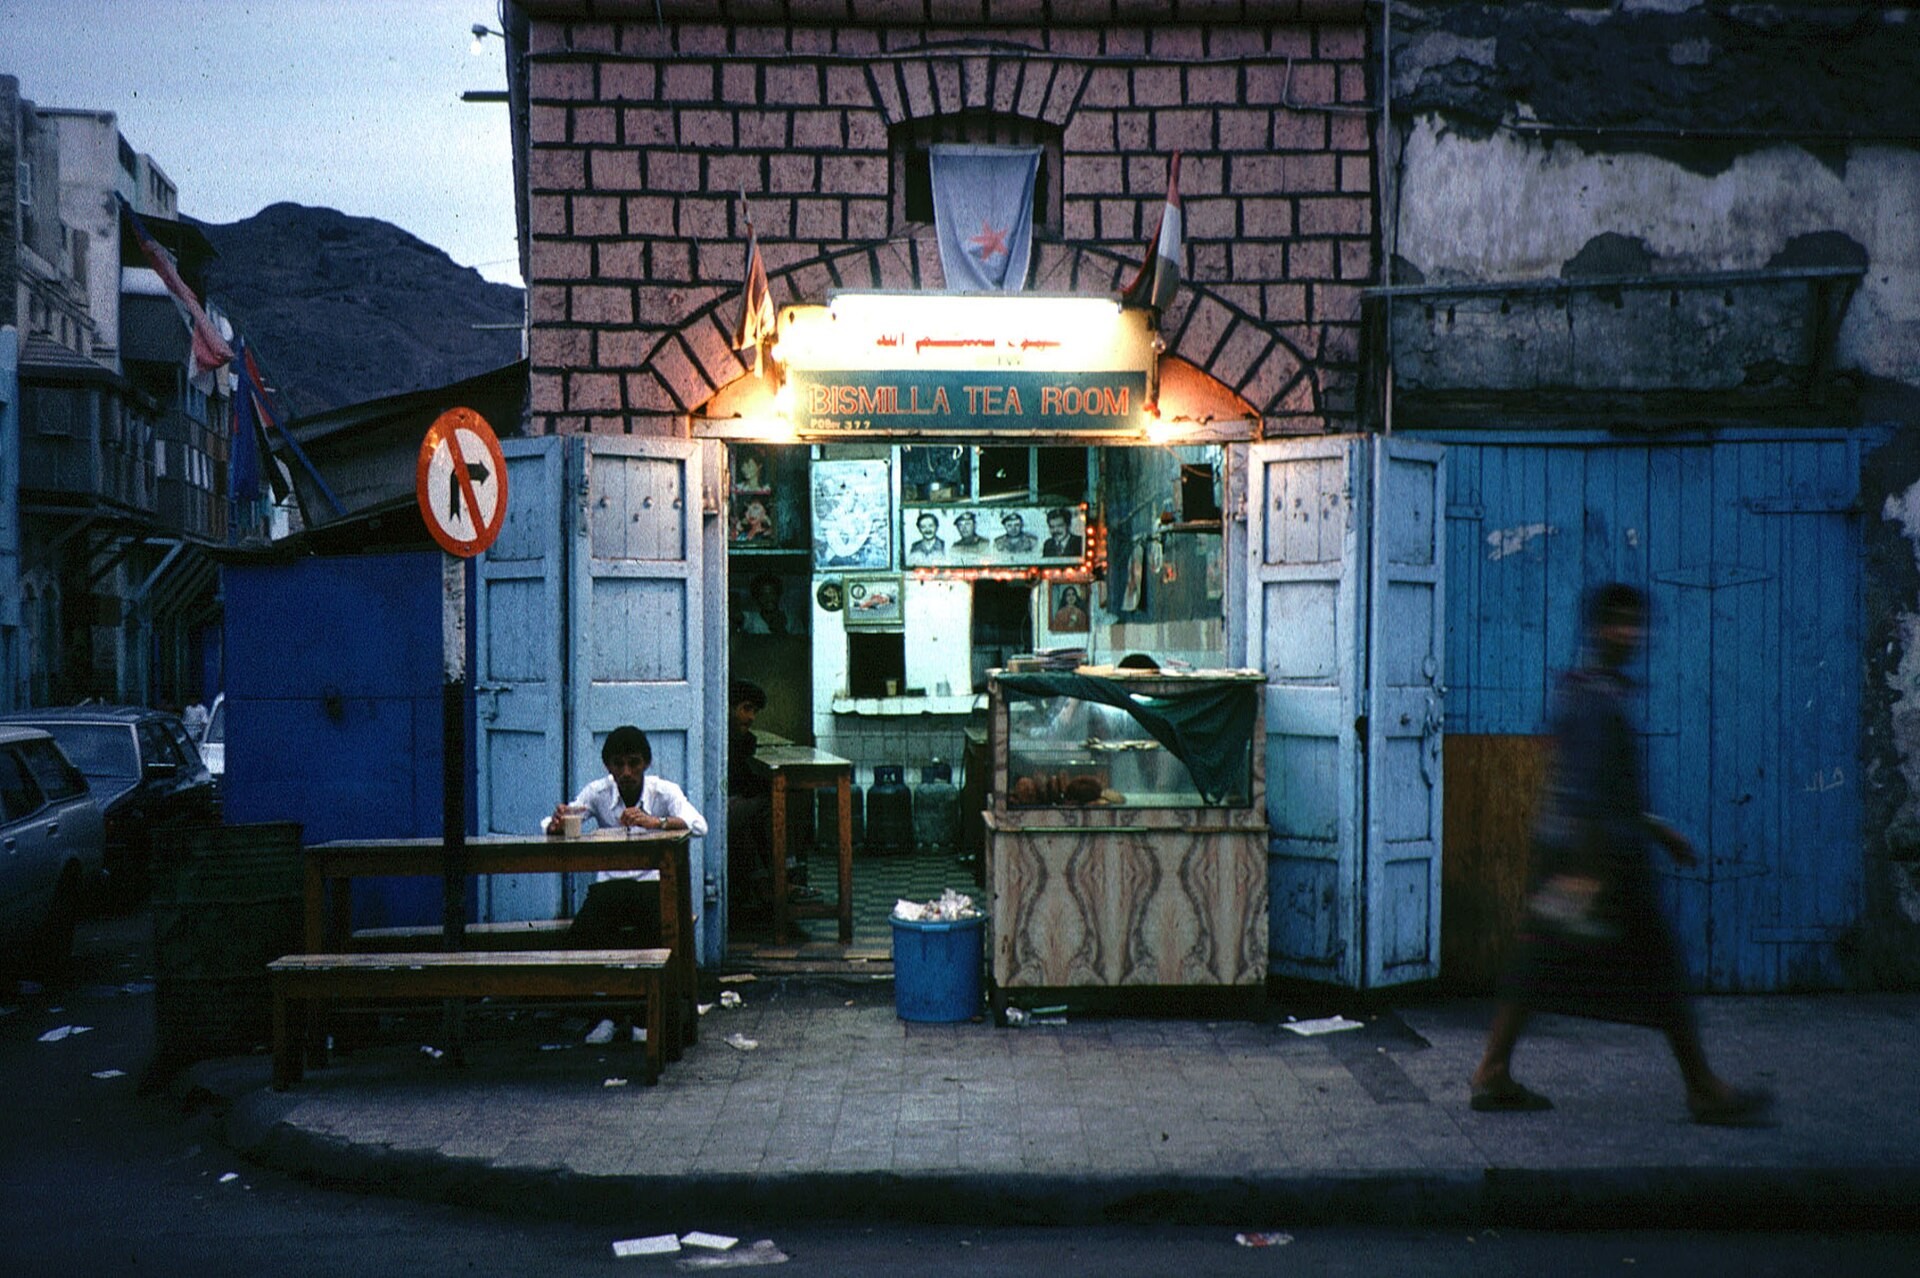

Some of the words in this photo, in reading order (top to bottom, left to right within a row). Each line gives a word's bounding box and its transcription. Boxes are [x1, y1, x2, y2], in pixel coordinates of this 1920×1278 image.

[808, 386, 951, 416] BISMILLA
[963, 386, 1023, 416] TEA
[1041, 386, 1130, 417] ROOM
